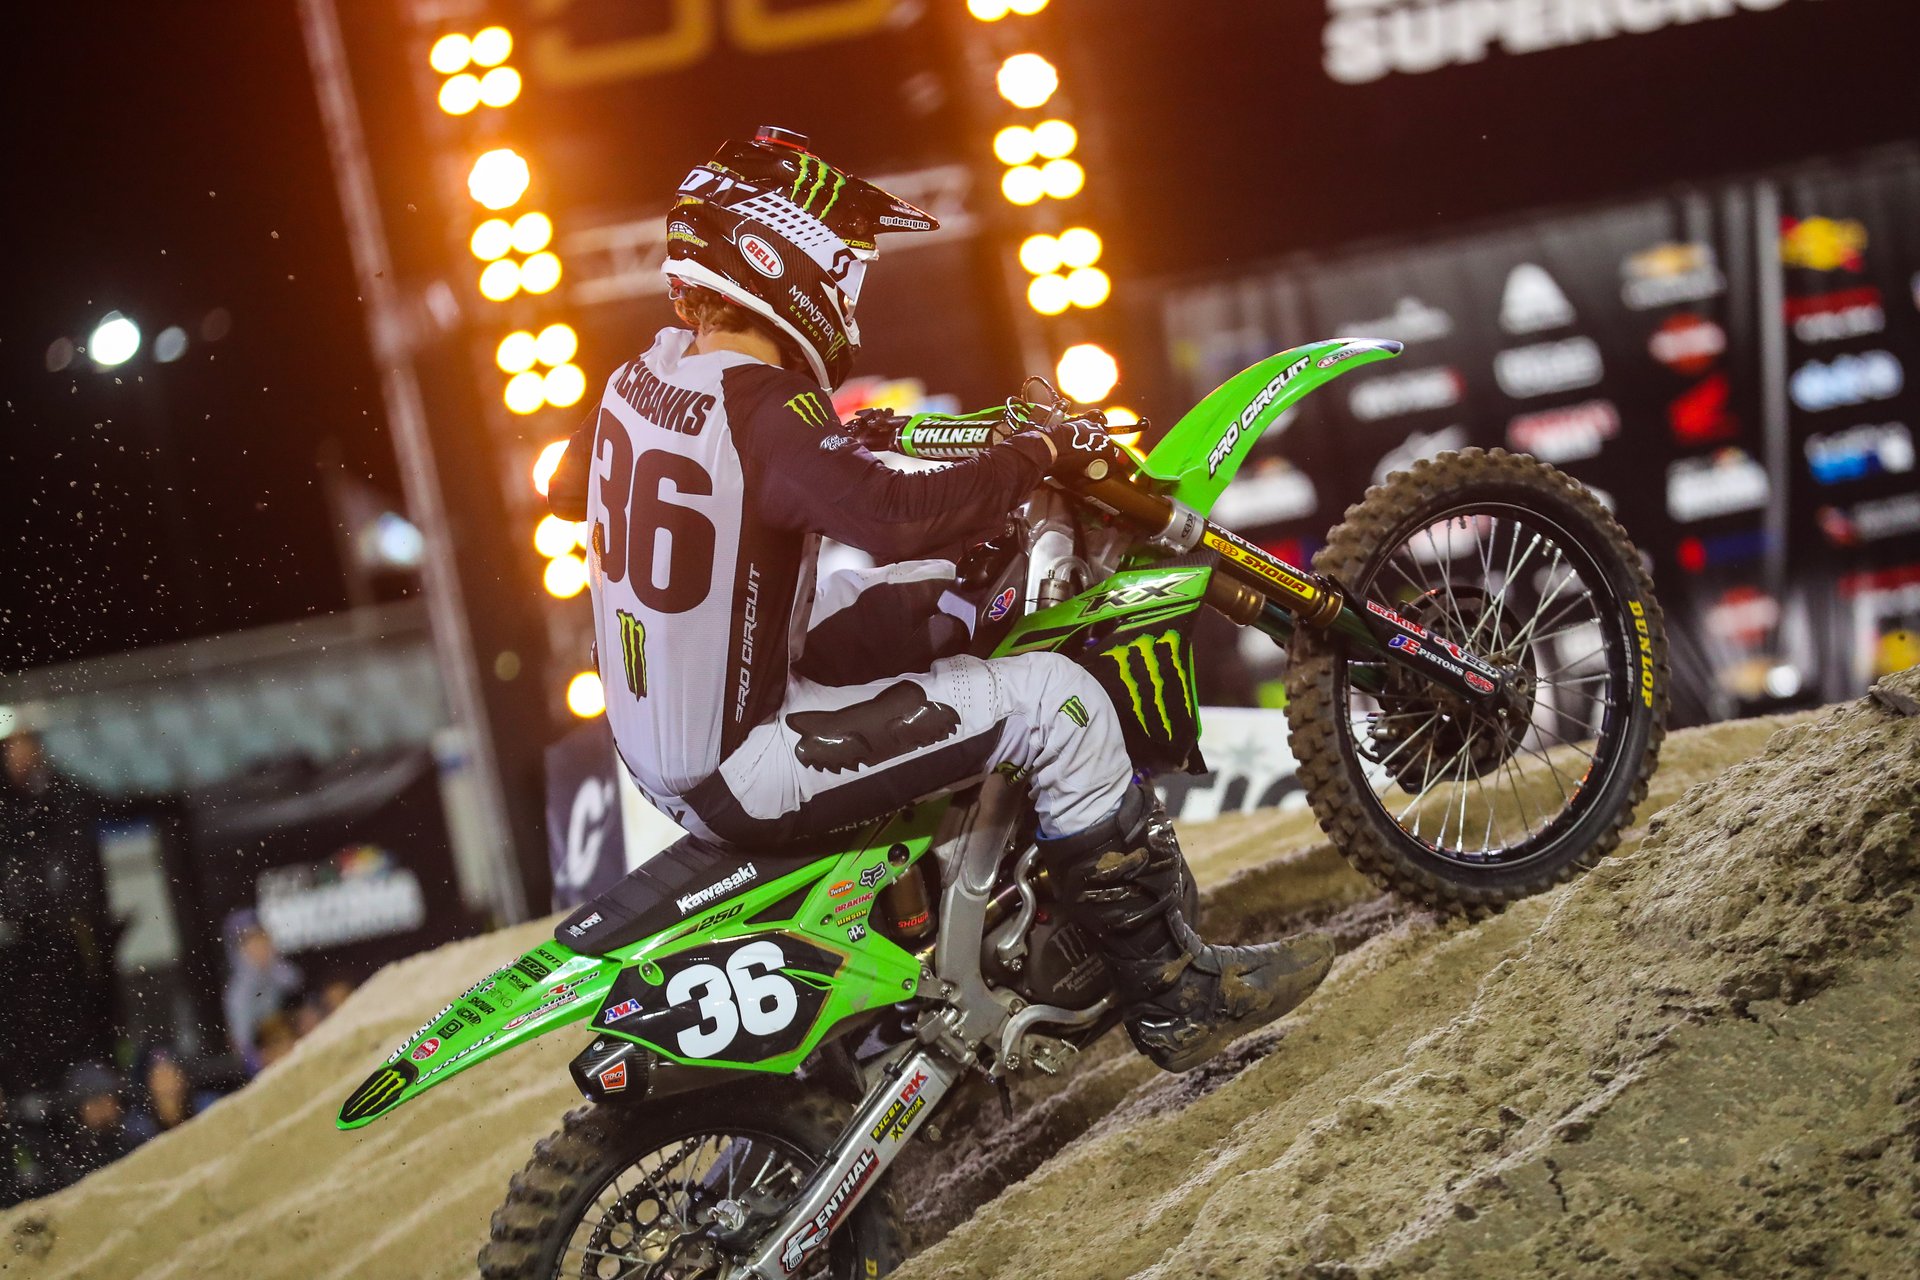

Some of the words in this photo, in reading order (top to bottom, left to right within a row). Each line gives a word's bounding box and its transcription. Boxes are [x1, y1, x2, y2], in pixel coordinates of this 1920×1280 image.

[880, 216, 930, 230] apdesigns
[745, 240, 776, 274] BELL
[788, 285, 835, 342] MONSTER
[789, 304, 823, 342] ENERGY
[613, 358, 717, 437] CHBANKS
[1208, 420, 1241, 481] PRO
[1239, 355, 1312, 432] CIRCUIT
[595, 407, 717, 615] 36
[1241, 555, 1308, 594] SHOWA
[741, 563, 761, 666] CIRCUIT
[1366, 600, 1428, 640] BRAKING
[1417, 648, 1465, 676] PISTONS
[1628, 600, 1655, 709] DUNLOP
[676, 862, 758, 914] Kawasaki
[835, 892, 873, 914] BRAKING
[697, 903, 745, 932] 250
[898, 912, 929, 929] SHOWA
[606, 999, 642, 1022] AMA
[666, 941, 798, 1059] 36
[900, 1070, 927, 1104] RK
[872, 1102, 902, 1139] EXCEL
[781, 1152, 875, 1271] RENTHAL
